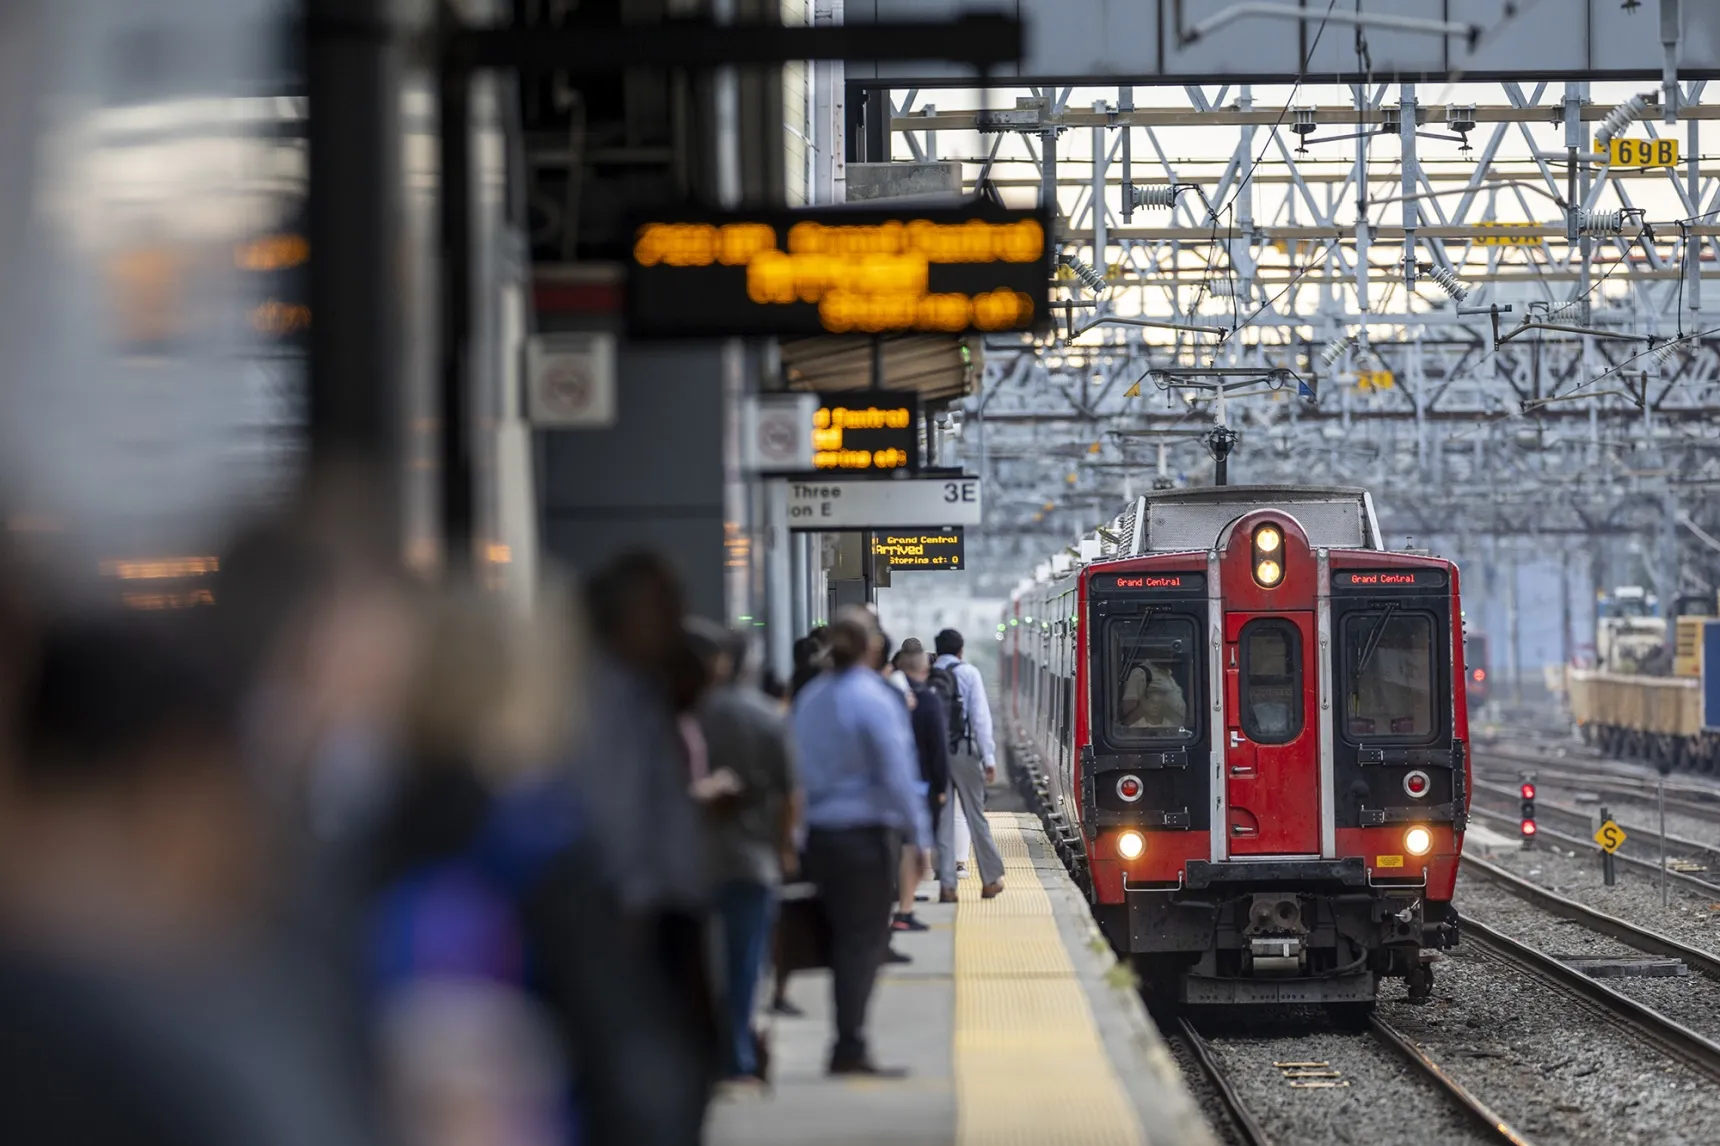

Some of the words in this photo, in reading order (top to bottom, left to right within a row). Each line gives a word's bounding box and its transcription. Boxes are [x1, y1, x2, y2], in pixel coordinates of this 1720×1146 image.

[1597, 140, 1673, 165] 69B
[792, 485, 842, 499] Three
[944, 482, 976, 503] 3E
[787, 504, 813, 518] on
[820, 501, 833, 517] E
[887, 536, 918, 544] Grand
[920, 536, 958, 544] Central
[876, 544, 924, 555] Arrived
[1117, 578, 1143, 587] Grand
[1146, 577, 1181, 586] Central
[1351, 574, 1377, 584] Grand
[1380, 574, 1415, 584] Central
[1603, 827, 1617, 849] S
